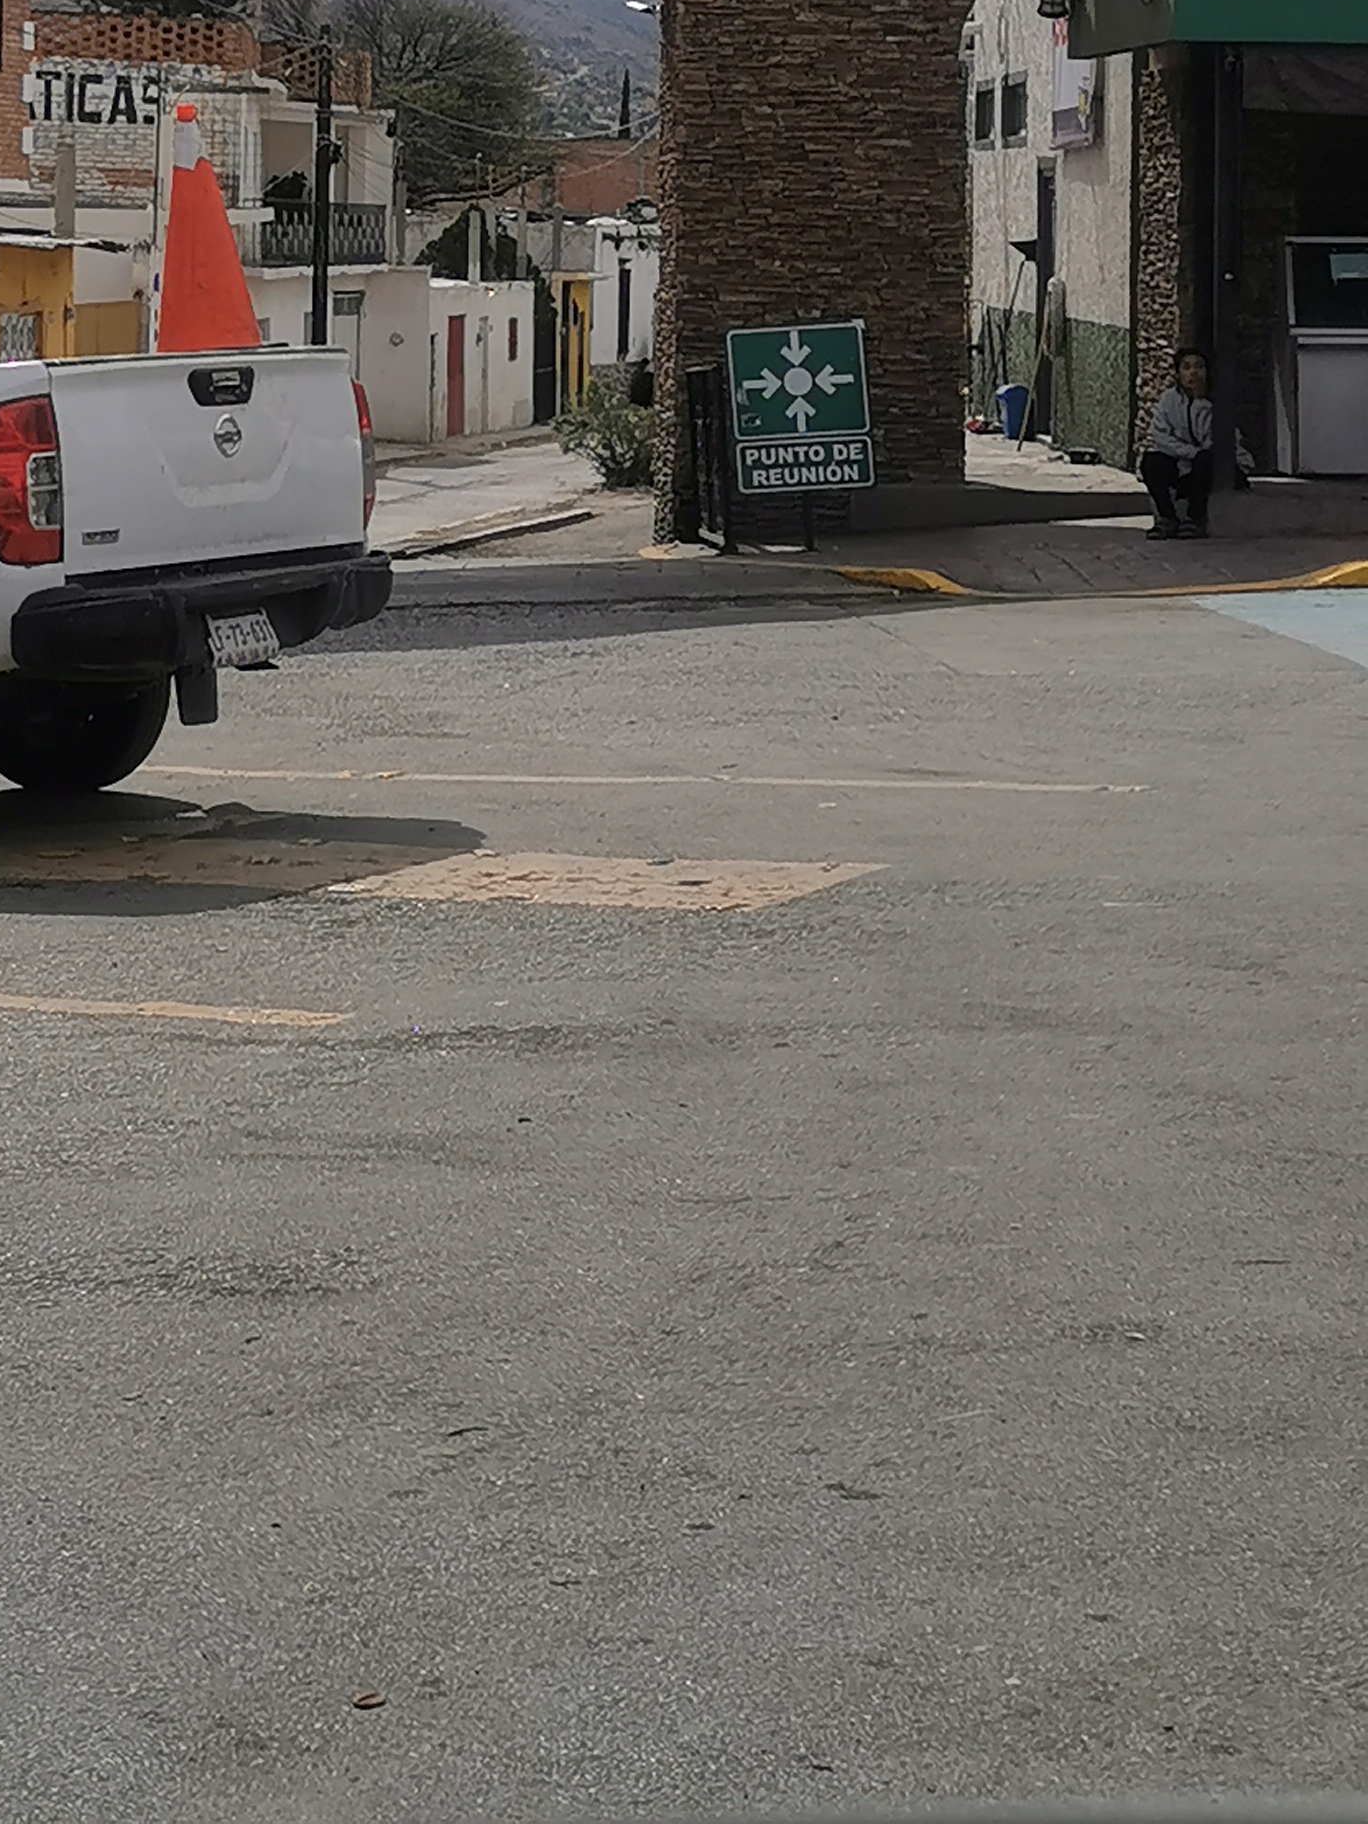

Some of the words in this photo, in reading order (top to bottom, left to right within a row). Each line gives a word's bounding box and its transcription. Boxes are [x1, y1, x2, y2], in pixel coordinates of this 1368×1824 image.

[29, 70, 160, 125] TICAS
[744, 444, 826, 466] PUNTO
[832, 442, 865, 460] DE
[752, 460, 860, 487] REUNIÓN
